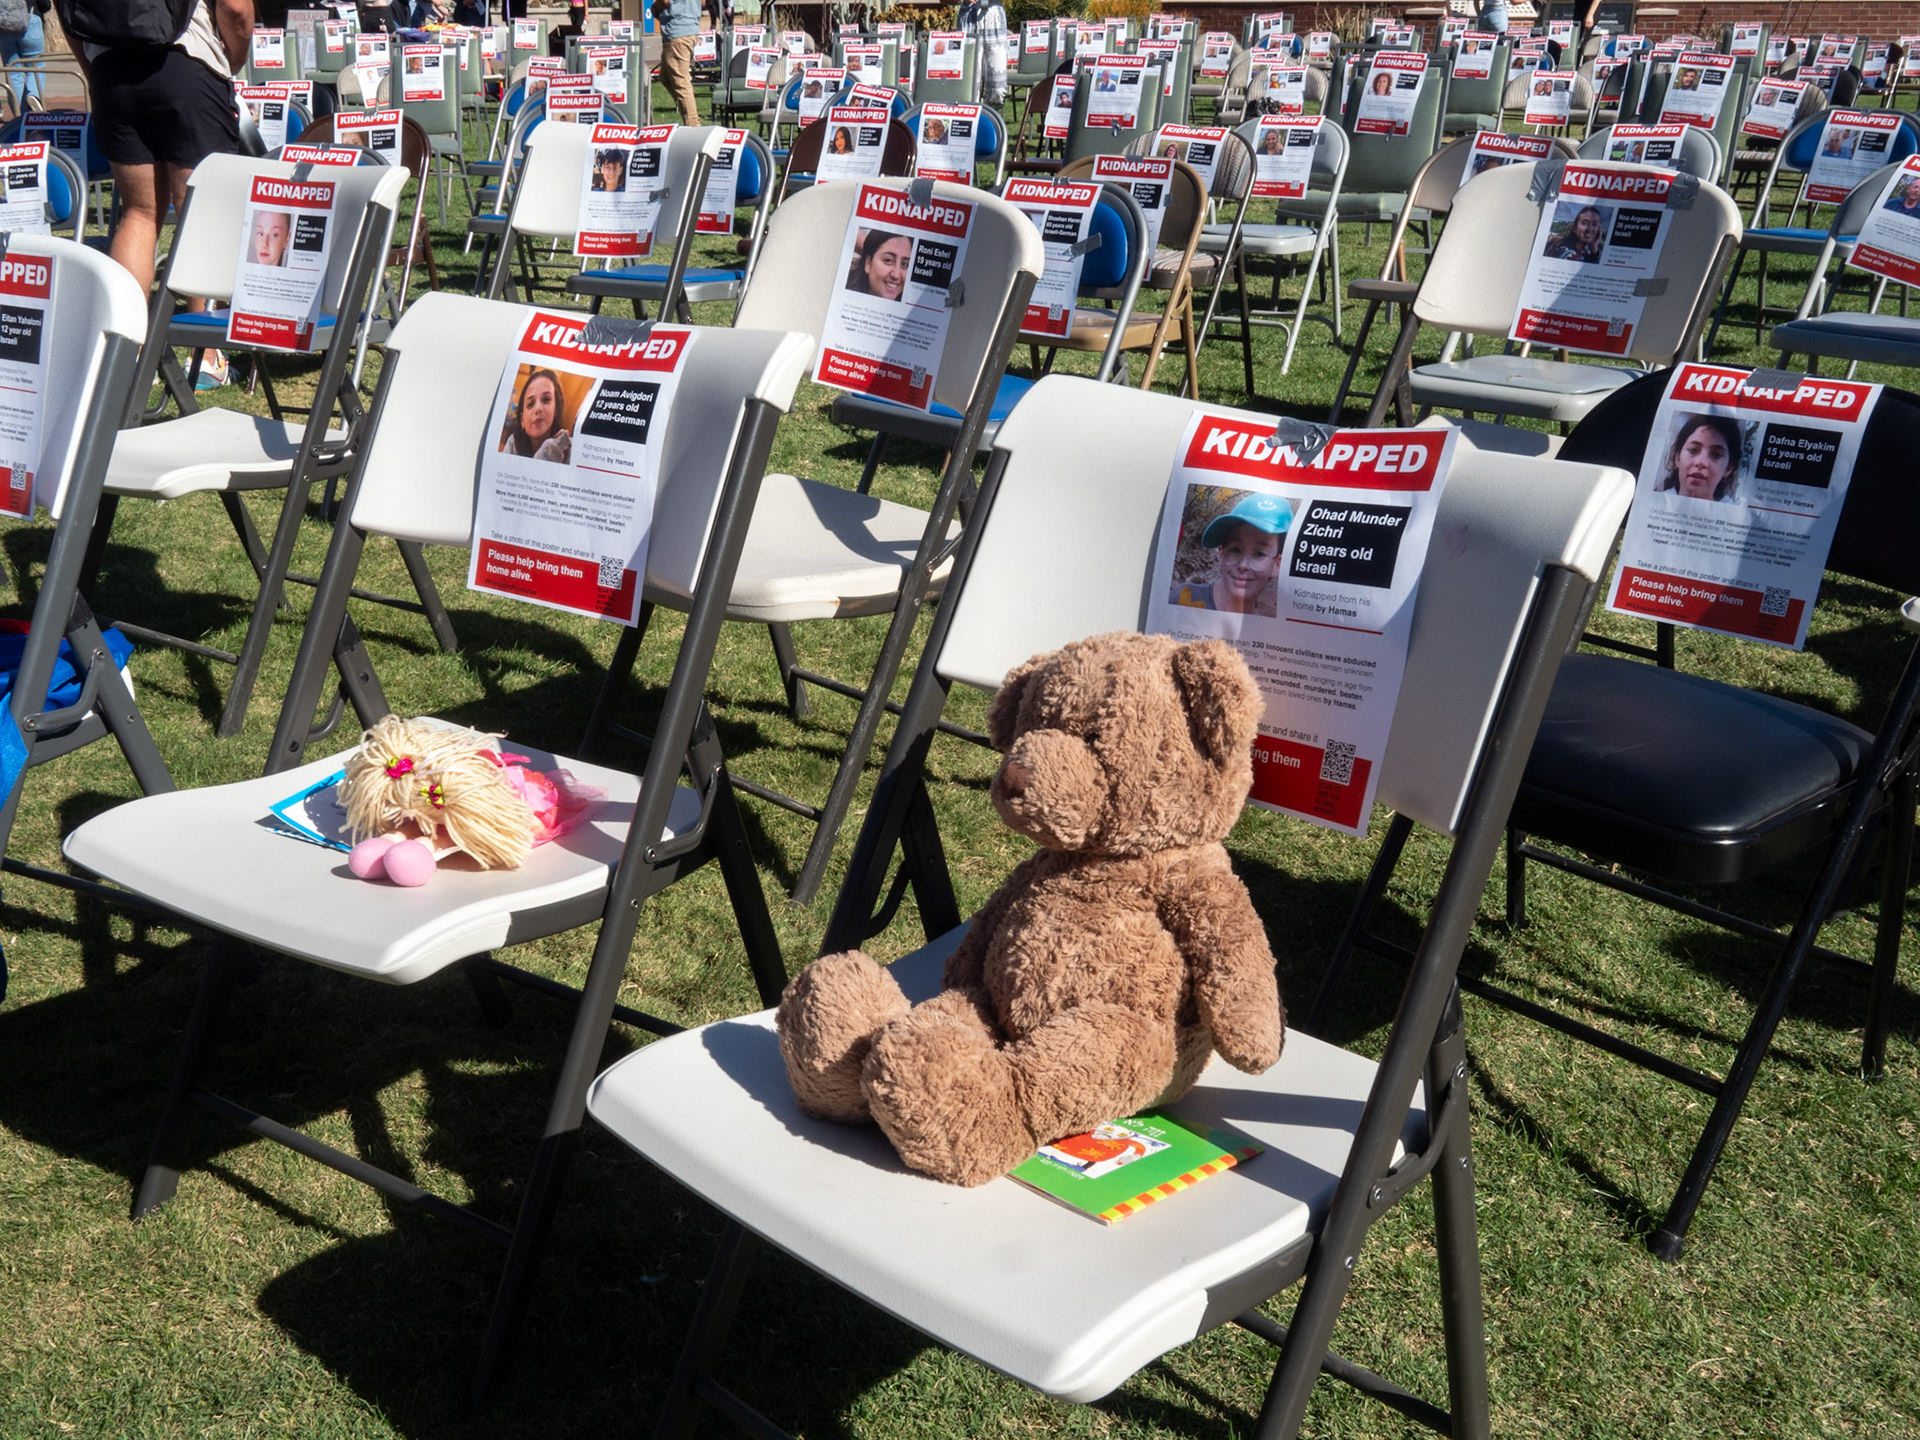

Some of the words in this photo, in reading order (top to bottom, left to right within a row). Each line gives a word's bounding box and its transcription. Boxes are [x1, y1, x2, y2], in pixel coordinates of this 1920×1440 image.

[1463, 30, 1497, 39] KIDNAPPED
[405, 46, 440, 54] KIDNAPPED
[590, 49, 625, 57] KIDNAPPED
[1099, 57, 1144, 65] KIDNAPPED
[1376, 58, 1424, 69] KIDNAPPED
[1681, 54, 1731, 66] KIDNAPPED
[1817, 57, 1850, 65] KIDNAPPED
[530, 67, 566, 76] KIDNAPPED
[551, 75, 592, 85] KIDNAPPED
[1764, 78, 1804, 89] KIDNAPPED
[241, 88, 286, 97] KIDNAPPED
[856, 85, 893, 97] KIDNAPPED
[551, 97, 600, 106] KIDNAPPED
[833, 110, 886, 120] KIDNAPPED
[926, 105, 976, 115] KIDNAPPED
[28, 115, 84, 123] KIDNAPPED
[339, 112, 397, 125] KIDNAPPED
[1834, 113, 1896, 127] KIDNAPPED
[597, 128, 668, 141] KIDNAPPED
[1165, 126, 1222, 137] KIDNAPPED
[1616, 125, 1681, 134] KIDNAPPED
[1481, 135, 1547, 153] KIDNAPPED
[286, 149, 353, 164] KIDNAPPED
[1100, 160, 1167, 174] KIDNAPPED
[1563, 171, 1670, 195] KIDNAPPED
[256, 181, 331, 202] KIDNAPPED
[1011, 184, 1091, 201] KIDNAPPED
[864, 192, 966, 227] KIDNAPPED
[1616, 221, 1624, 229] 26
[1624, 223, 1640, 231] years
[1630, 215, 1658, 224] Argamani
[918, 245, 934, 255] Roni
[917, 255, 925, 265] 19
[924, 258, 942, 269] years
[942, 261, 952, 270] old
[914, 265, 934, 277] Israeli
[1, 313, 17, 323] Eitan
[18, 315, 42, 327] Yahalomi
[1527, 314, 1549, 325] Please
[1550, 318, 1565, 328] help
[1565, 321, 1582, 331] bring
[1582, 324, 1599, 333] them
[1, 324, 9, 334] 12
[9, 327, 22, 335] year
[22, 328, 32, 337] old
[1524, 323, 1543, 333] home
[1544, 326, 1562, 335] alive.
[0, 335, 18, 346] Israeli
[827, 365, 848, 376] home
[848, 370, 867, 381] alive.
[830, 355, 854, 368] Please
[854, 361, 869, 373] help
[869, 365, 887, 378] bring
[887, 369, 903, 380] them
[599, 388, 620, 398] Noam
[620, 389, 654, 403] Avigdori
[595, 399, 604, 408] 12
[603, 401, 625, 412] years
[625, 402, 640, 413] old
[588, 410, 647, 428] Israeli-German
[582, 442, 612, 456] Kidnapped
[612, 447, 625, 456] from
[1768, 434, 1796, 448] Dafna
[1797, 438, 1836, 453] Elyakim
[581, 452, 589, 460] her
[589, 453, 606, 462] home
[606, 456, 614, 464] by
[614, 457, 635, 468] Hamas
[1766, 446, 1778, 457] 15
[1778, 449, 1805, 461] years
[1807, 452, 1823, 463] old
[1762, 458, 1793, 471] Israeli
[1311, 507, 1348, 522] Ohad
[1349, 511, 1403, 527] Munder
[1303, 523, 1344, 539] Zichri
[490, 530, 504, 540] Take
[508, 535, 525, 546] photo
[524, 538, 531, 546] of
[531, 539, 542, 548] this
[542, 541, 561, 554] poster
[561, 544, 573, 554] and
[573, 547, 591, 558] share
[590, 552, 595, 560] it
[1299, 540, 1308, 553] 9
[1309, 544, 1347, 558] years
[1351, 547, 1374, 561] old
[488, 548, 515, 564] Please
[516, 554, 536, 570] help
[536, 559, 560, 576] bring
[560, 564, 584, 579] them
[1295, 558, 1337, 576] Israeli
[486, 562, 510, 577] home
[510, 568, 533, 582] alive.
[1637, 559, 1653, 570] Take
[1659, 564, 1678, 575] photo
[1678, 567, 1686, 576] of
[1686, 569, 1700, 578] this
[1700, 571, 1722, 583] poster
[1721, 575, 1735, 585] and
[1735, 577, 1755, 589] share
[1293, 588, 1337, 603] Kidnapped
[1339, 594, 1357, 605] from
[1358, 596, 1371, 607] his
[1628, 587, 1657, 602] home
[1658, 595, 1685, 608] alive.
[1631, 576, 1665, 591] Please
[1667, 582, 1689, 597] help
[1690, 587, 1717, 603] bring
[1719, 593, 1745, 606] them
[1292, 601, 1314, 612] home
[1316, 603, 1327, 614] by
[1328, 605, 1358, 618] Hamas
[1252, 640, 1265, 650] 230
[1266, 642, 1294, 655] innocent
[1295, 648, 1323, 660] civilians
[1325, 654, 1342, 663] were
[1343, 655, 1377, 668] abducted
[1271, 677, 1301, 689] wounded,
[1304, 683, 1338, 696] murdered,
[1340, 690, 1363, 702] beaten,
[1257, 722, 1271, 732] ster
[1272, 726, 1288, 736] and
[1290, 729, 1312, 742] share
[1313, 733, 1319, 743] it
[1251, 746, 1269, 764] ing
[1272, 750, 1301, 769] them
